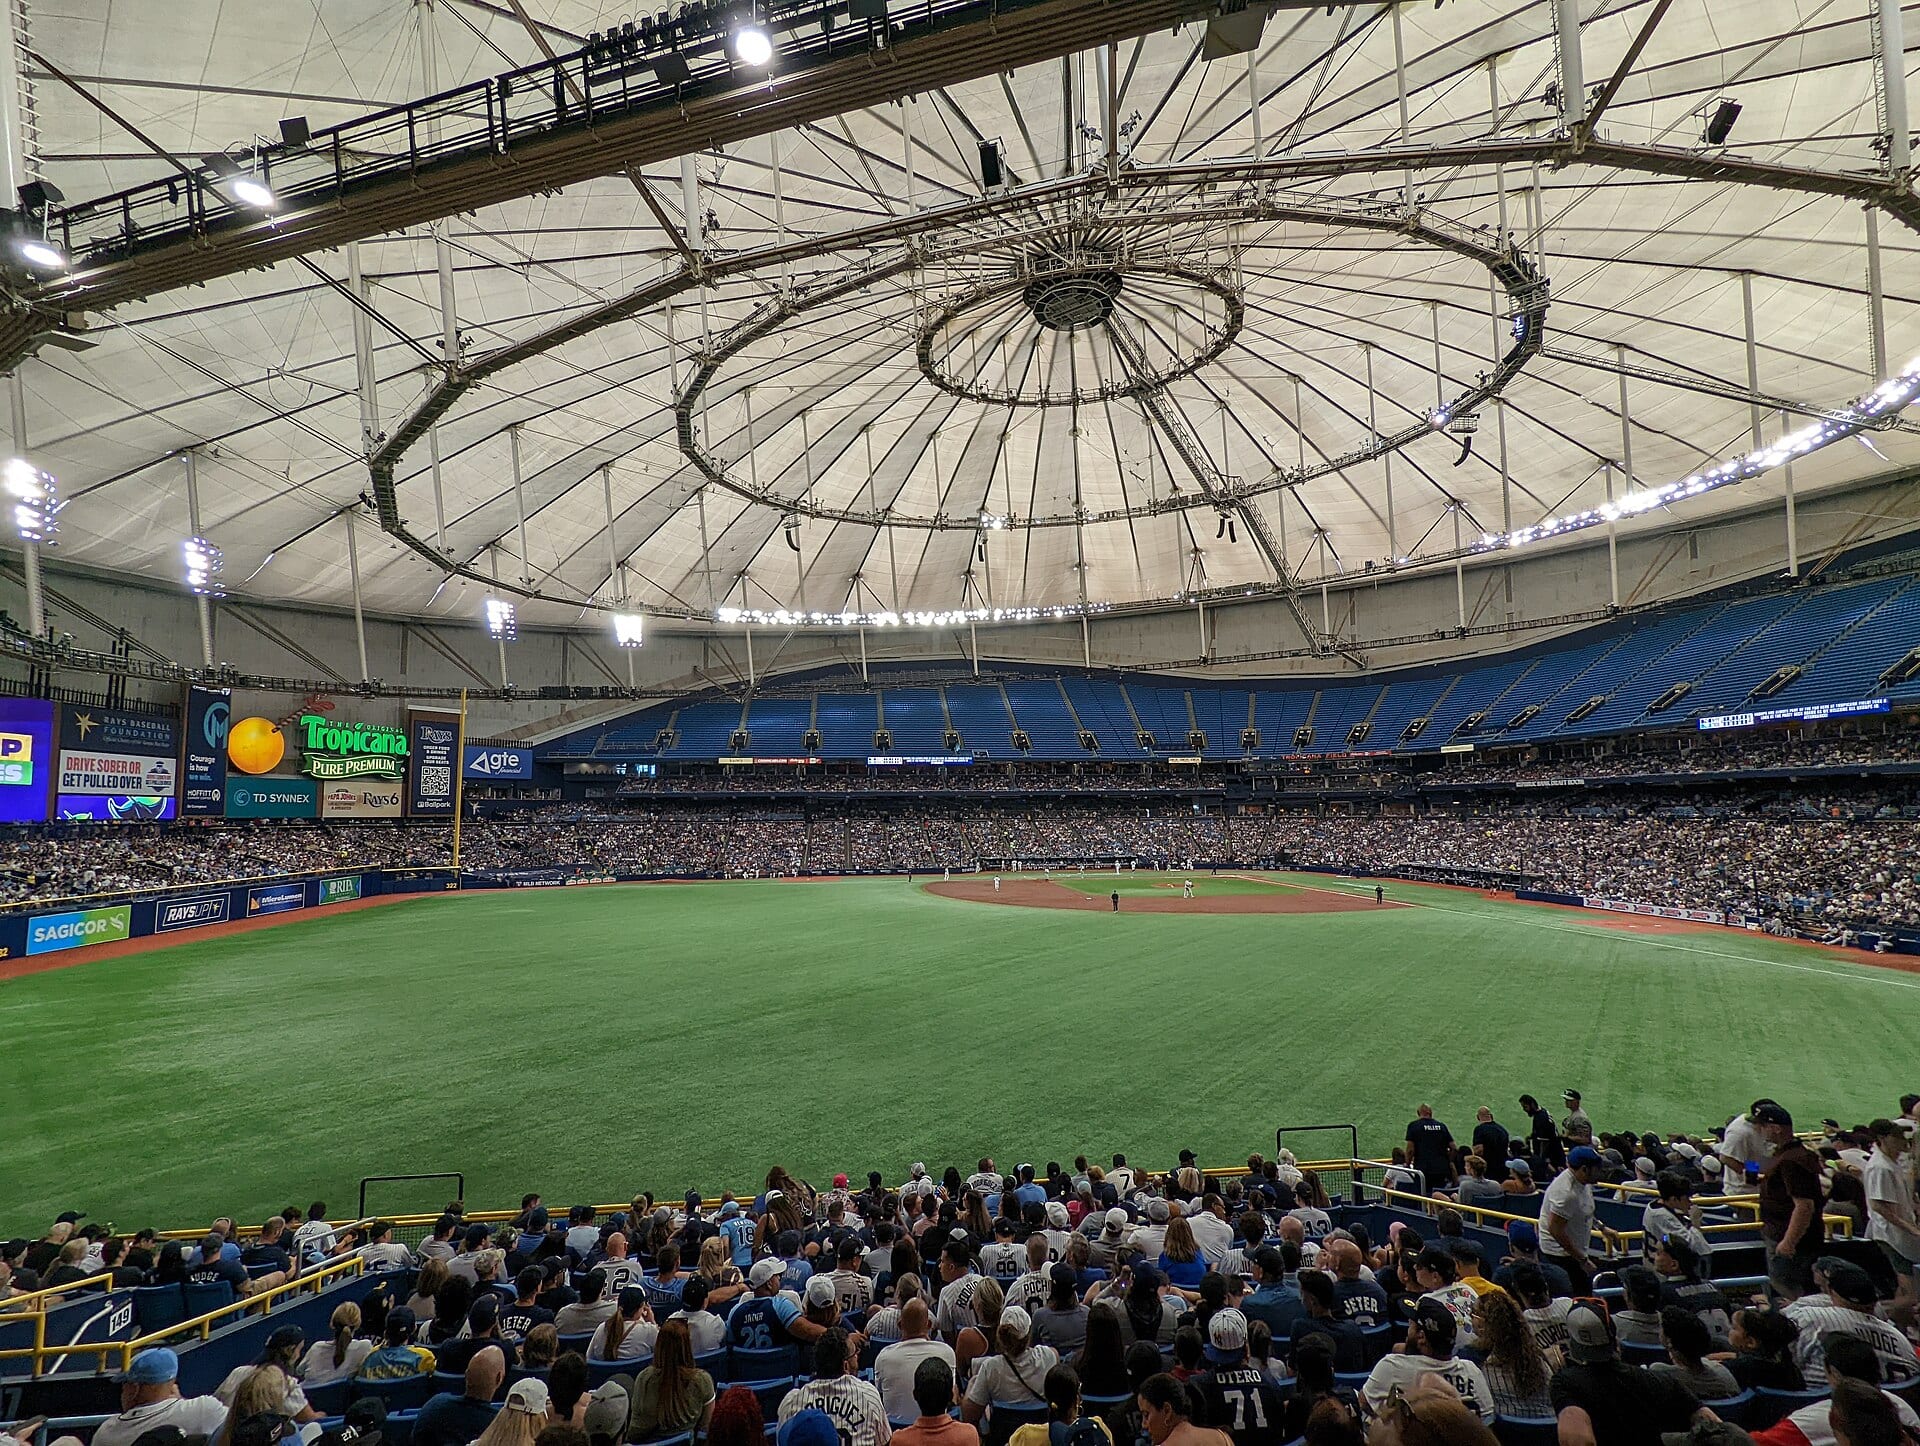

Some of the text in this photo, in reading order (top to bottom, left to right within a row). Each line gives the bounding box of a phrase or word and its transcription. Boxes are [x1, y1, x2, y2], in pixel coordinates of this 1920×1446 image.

[104, 716, 171, 731] RAYS BASEBALL
[104, 727, 170, 740] FOUNDATION
[300, 714, 407, 755] Tropicana
[420, 726, 453, 743] RAYS
[66, 757, 141, 774] DRIVE SOBER OR
[189, 763, 209, 772] is how
[190, 754, 215, 765] Courage
[312, 758, 395, 775] PURE PREMIUM
[490, 751, 520, 770] gte
[63, 773, 82, 787] GET
[83, 773, 118, 788] PULLED
[120, 776, 142, 790] OVER
[187, 789, 211, 797] MOFFITT
[253, 793, 309, 803] TD SYNNEX
[261, 893, 303, 904] MicroLumen
[33, 919, 108, 943] SAGICOR
[1119, 1173, 1130, 1191] 7
[737, 1226, 754, 1247] 18
[190, 1271, 219, 1283] JUDGE
[996, 1260, 1017, 1278] 99
[604, 1266, 631, 1295] 2
[1343, 1296, 1378, 1315] JETER
[110, 1309, 129, 1332] 149
[502, 1316, 531, 1331] JETER
[740, 1323, 773, 1348] 26
[1216, 1369, 1262, 1384] OTERO
[1223, 1387, 1268, 1430] 71
